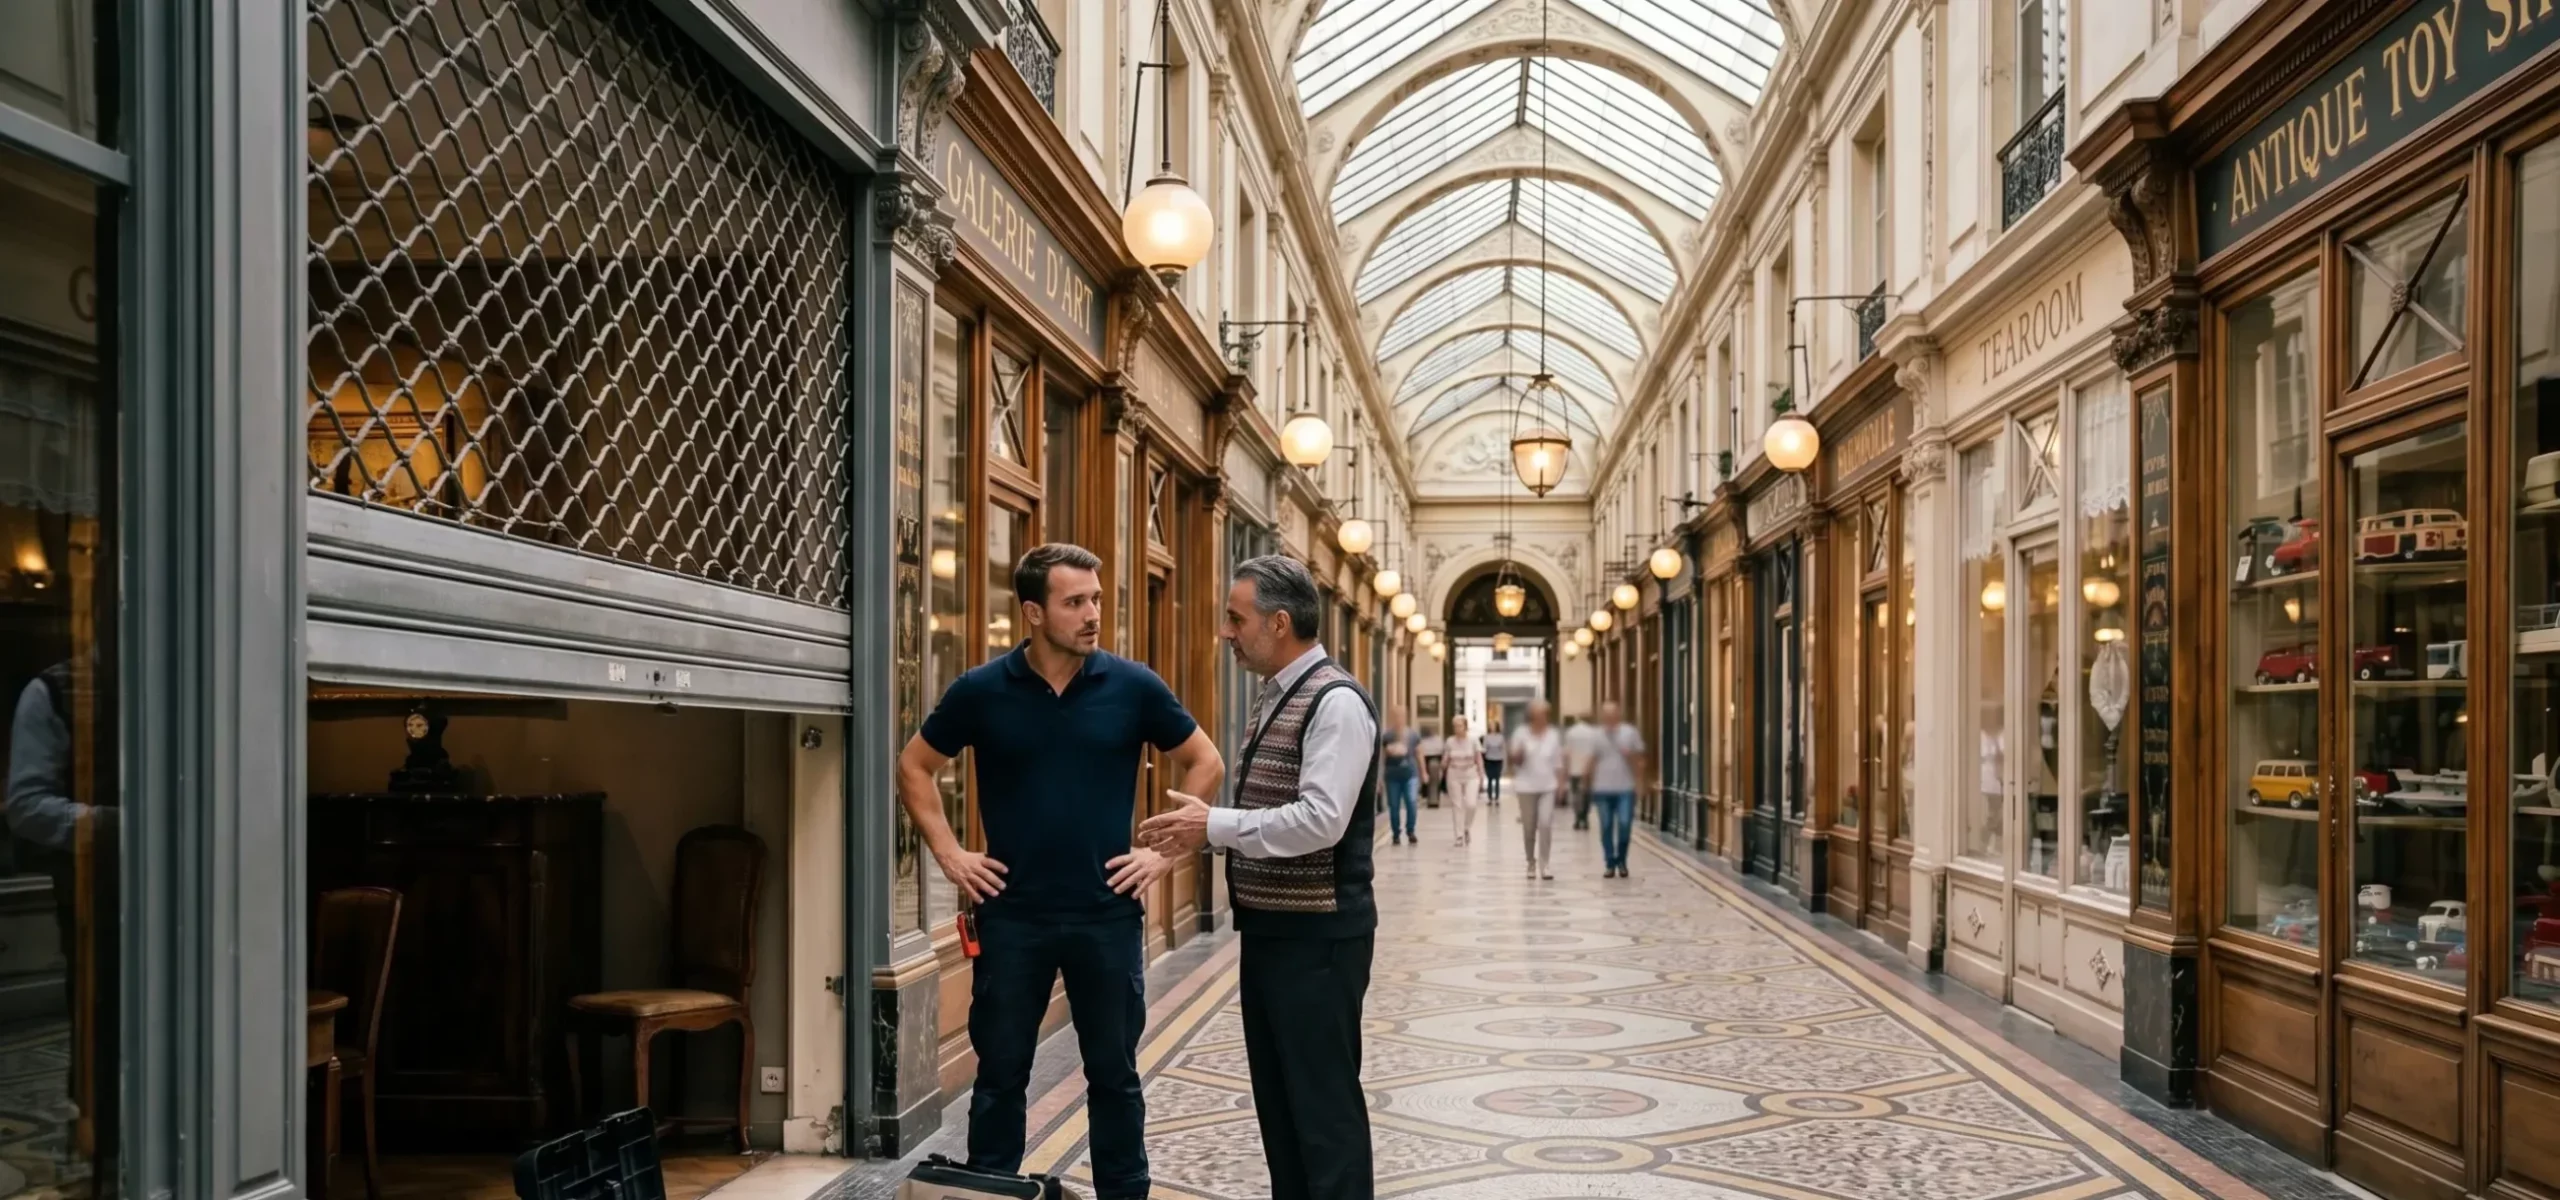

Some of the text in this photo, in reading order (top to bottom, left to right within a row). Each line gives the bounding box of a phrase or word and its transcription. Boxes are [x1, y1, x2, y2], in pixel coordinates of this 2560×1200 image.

[2229, 66, 2368, 224] ANTIQUE
[2382, 0, 2462, 118] TOY
[946, 140, 1094, 337] GALERIE D'ART
[1978, 271, 2084, 386] TEAROOM
